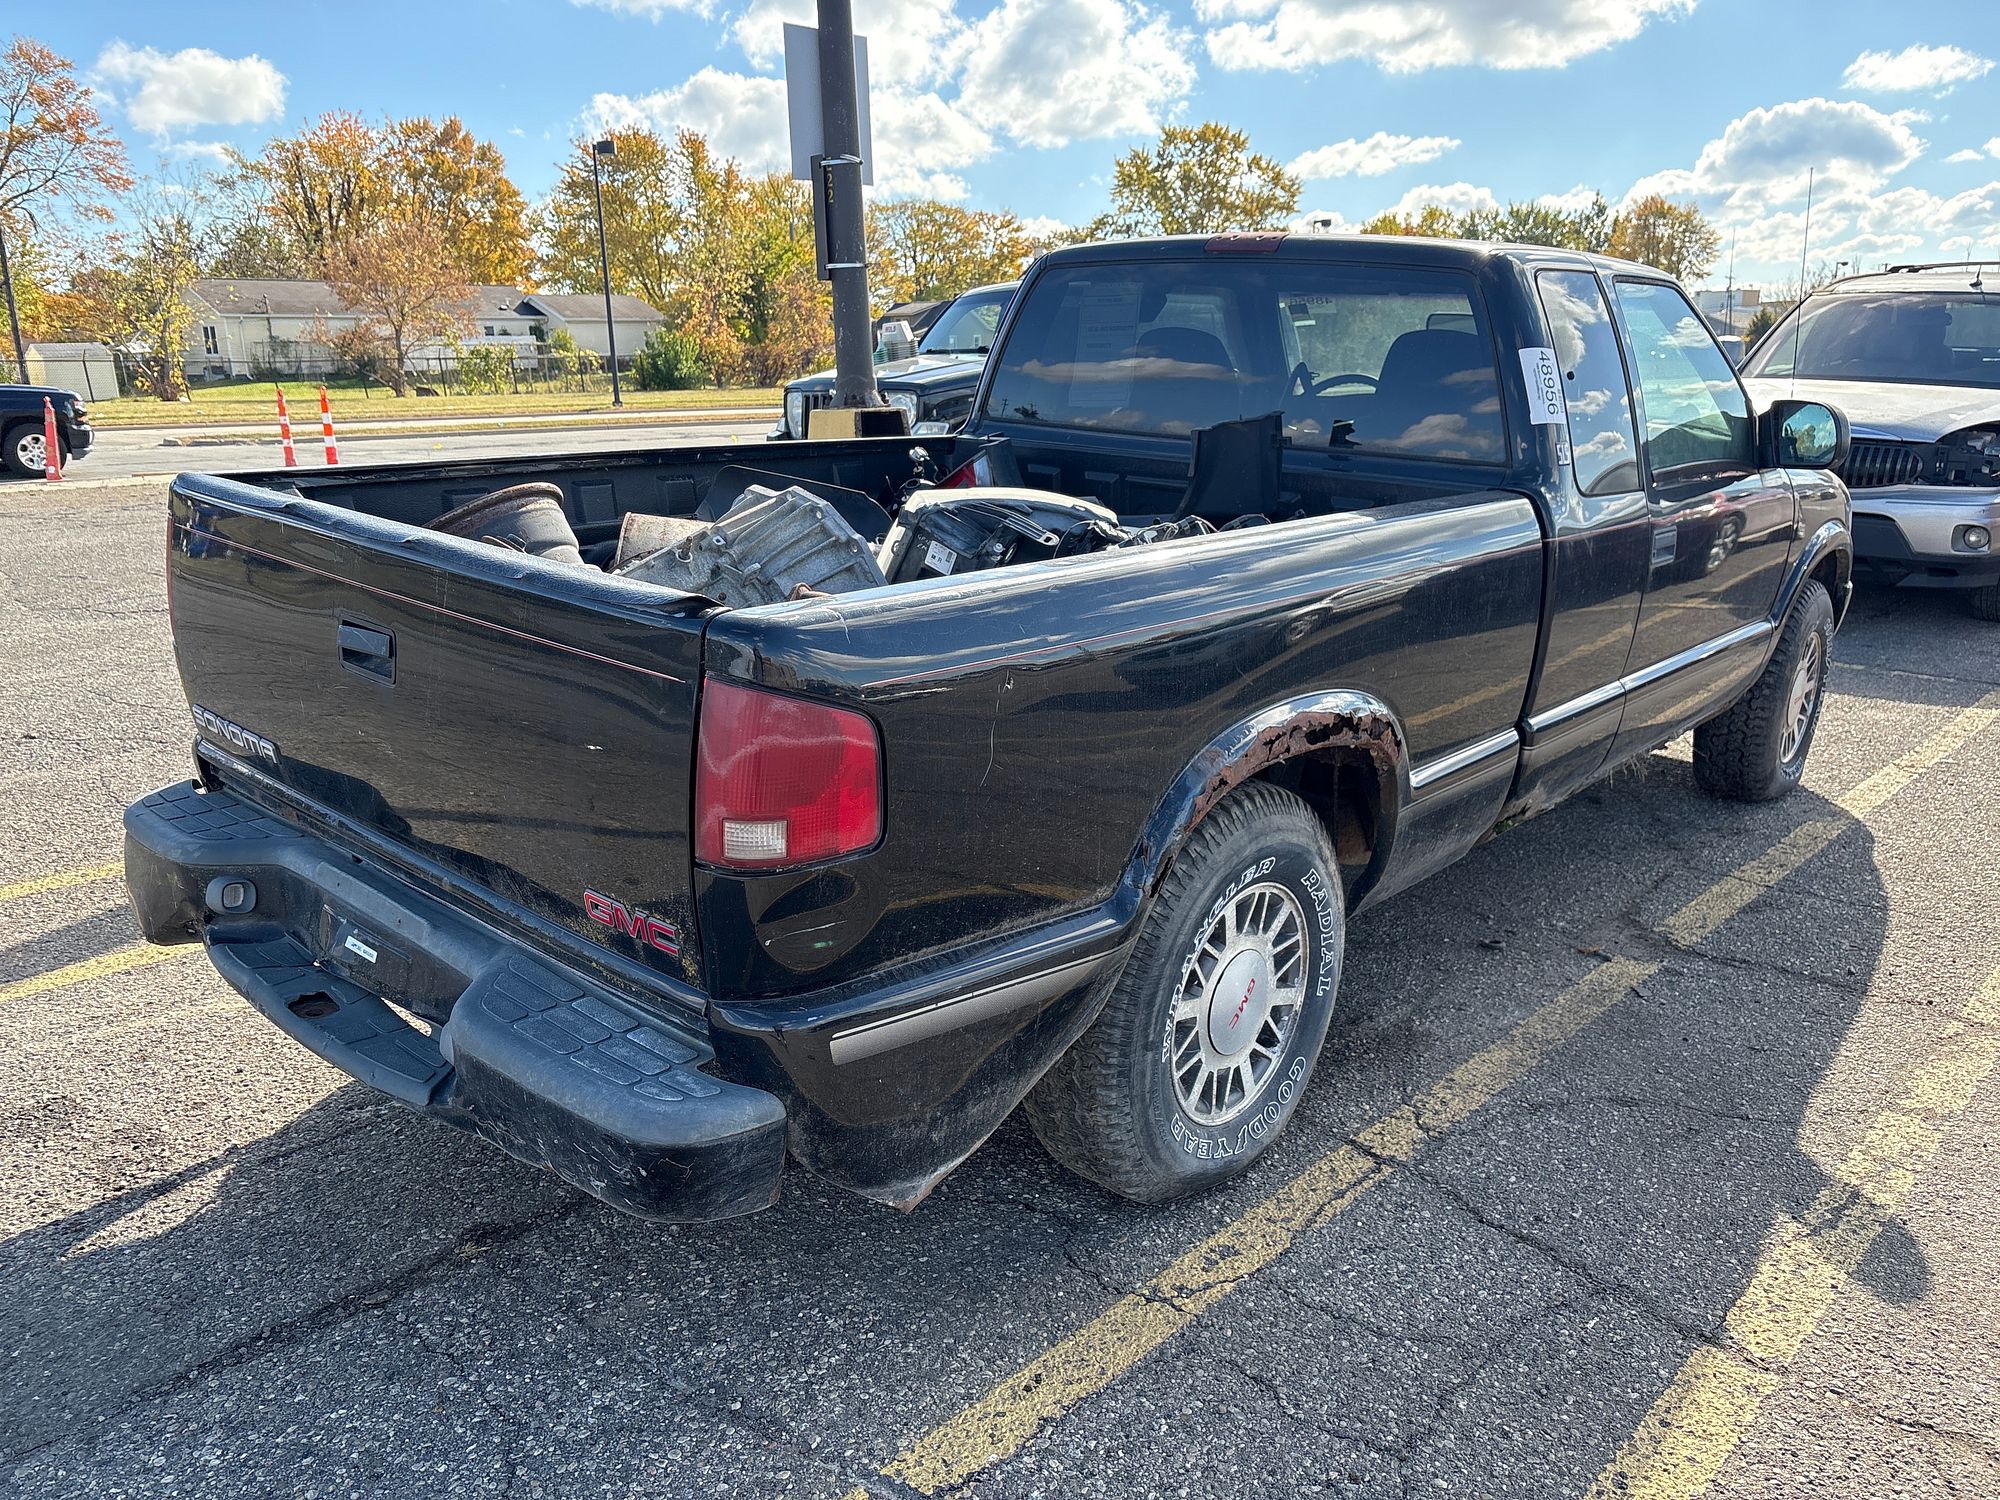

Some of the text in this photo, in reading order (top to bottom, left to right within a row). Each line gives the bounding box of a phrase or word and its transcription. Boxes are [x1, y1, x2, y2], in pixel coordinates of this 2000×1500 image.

[1538, 350, 1559, 415] 48956
[192, 704, 278, 764] SONOMA
[583, 888, 680, 956] GMC
[1301, 869, 1334, 997] RADIAL
[1161, 856, 1277, 1063] WRANGLER
[1229, 978, 1256, 1030] GMC
